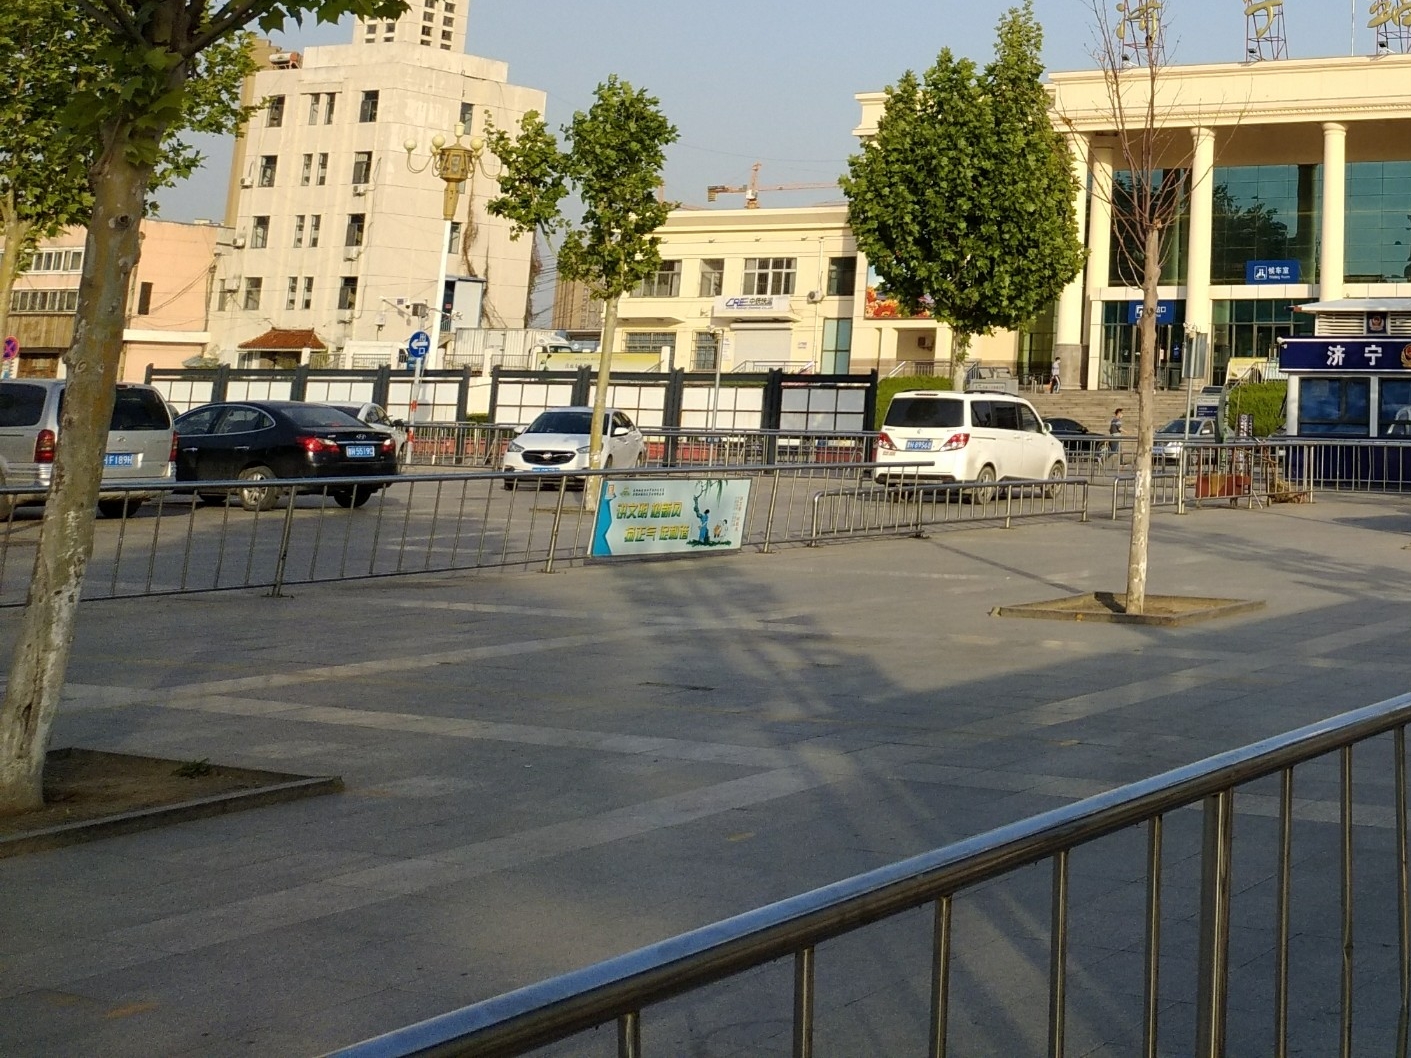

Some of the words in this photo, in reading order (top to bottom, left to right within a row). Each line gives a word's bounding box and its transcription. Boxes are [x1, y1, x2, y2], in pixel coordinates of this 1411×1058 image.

[1267, 266, 1290, 275] 候车室
[1326, 345, 1383, 366] 济宁
[616, 502, 649, 519] 讲文明
